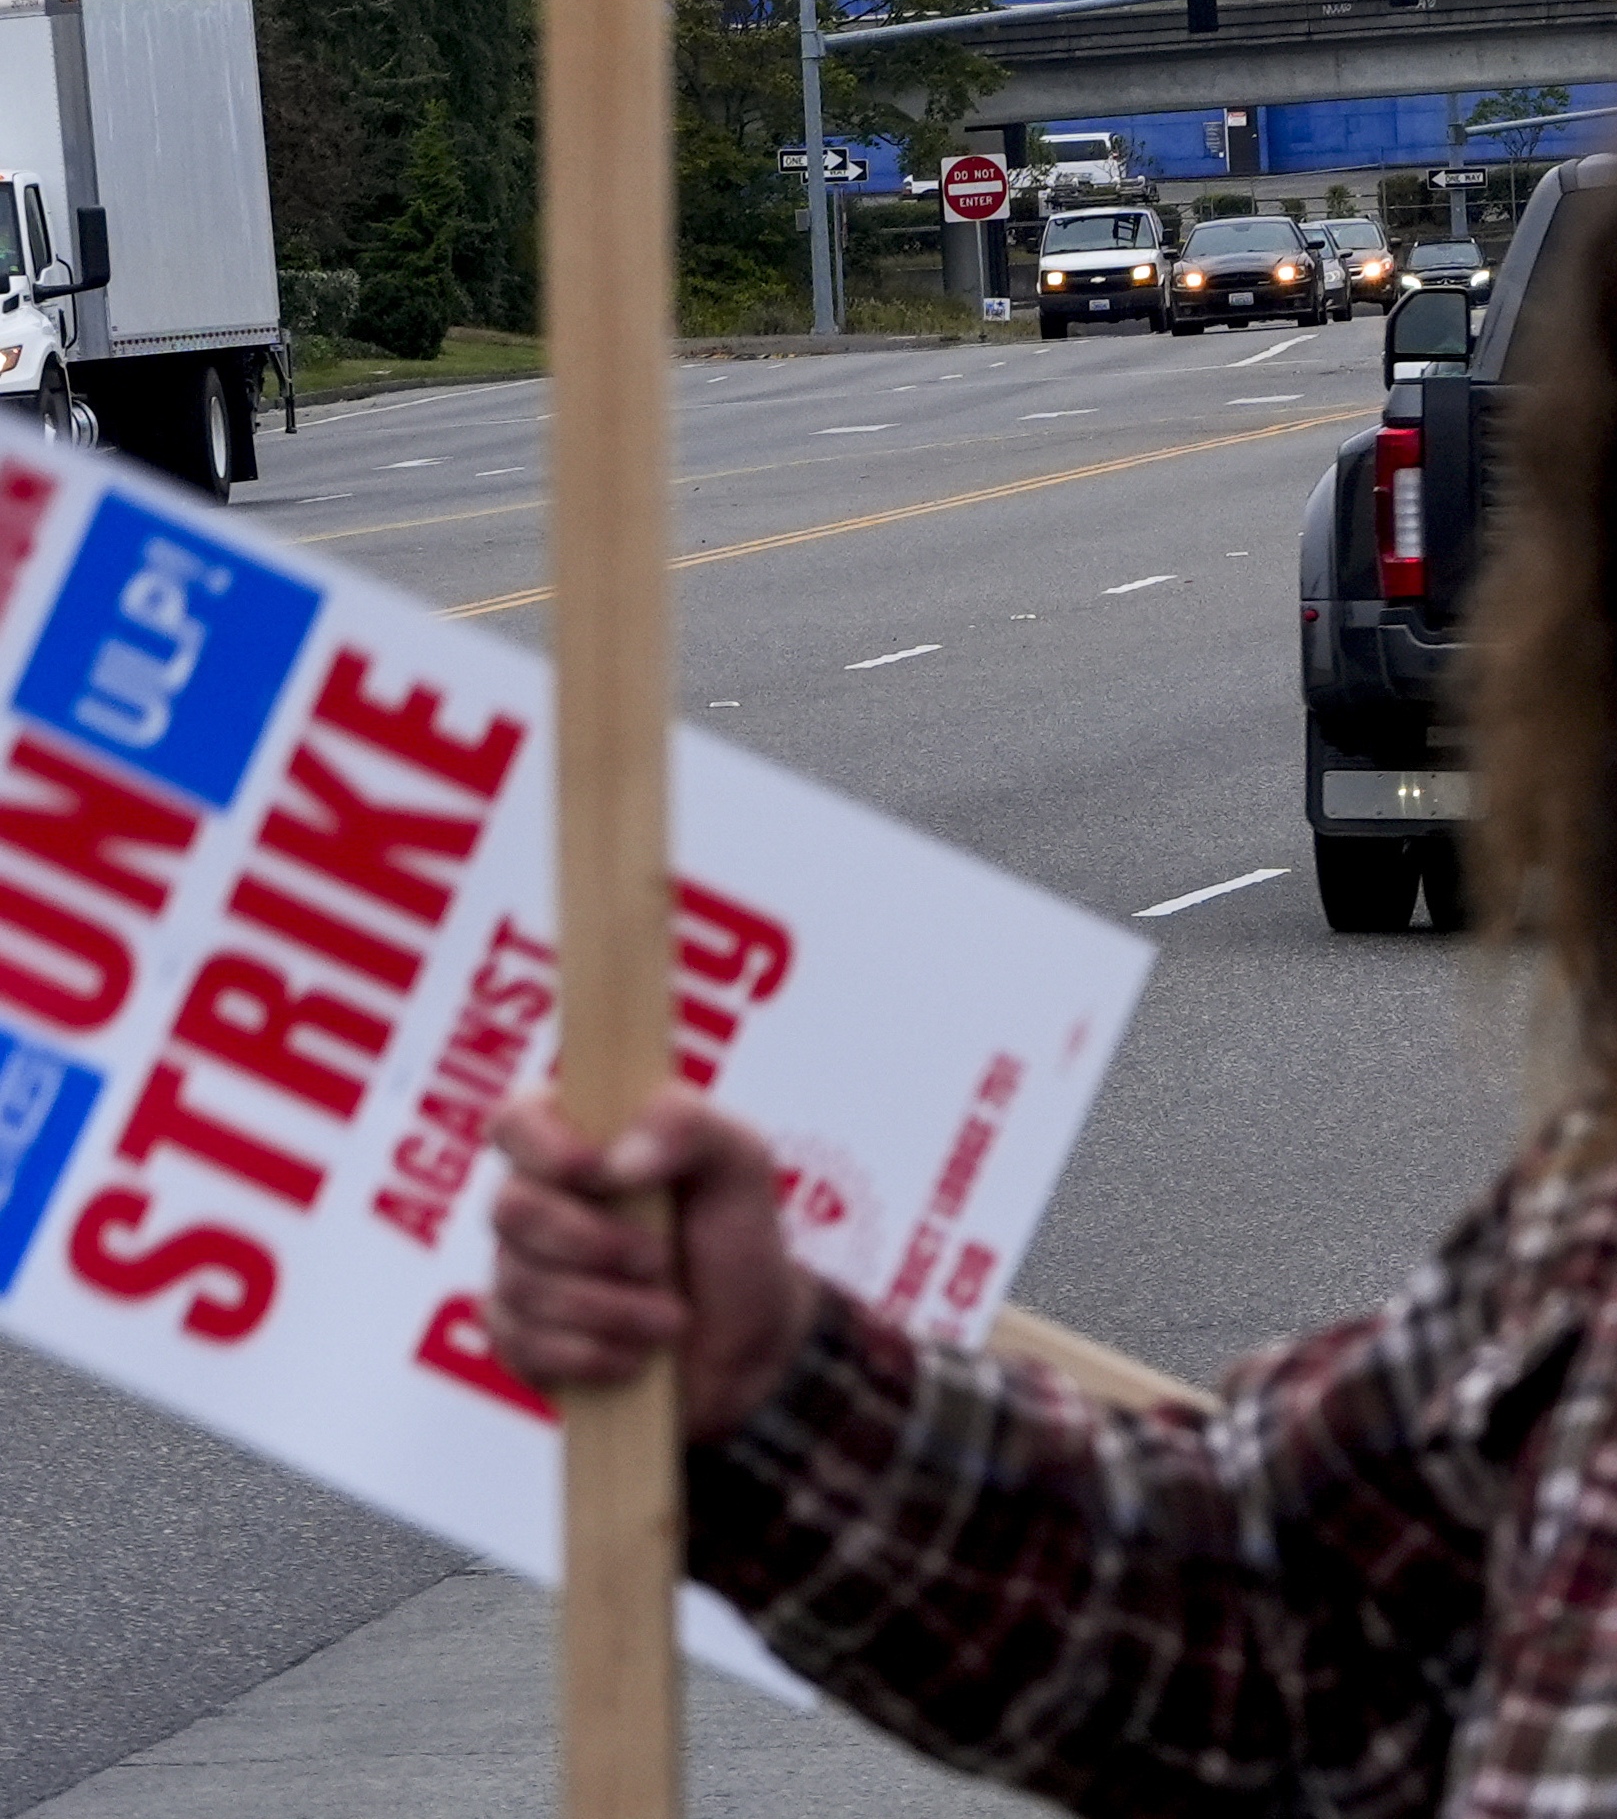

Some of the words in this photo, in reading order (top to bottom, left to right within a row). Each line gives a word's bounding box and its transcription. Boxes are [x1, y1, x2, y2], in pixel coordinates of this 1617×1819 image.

[785, 156, 804, 167] ONE
[953, 170, 969, 181] DO
[974, 168, 996, 179] NOT
[959, 196, 993, 208] ENTER
[71, 535, 235, 751] ULP!
[64, 642, 530, 1348] STRIKE
[368, 914, 558, 1248] AGAINST
